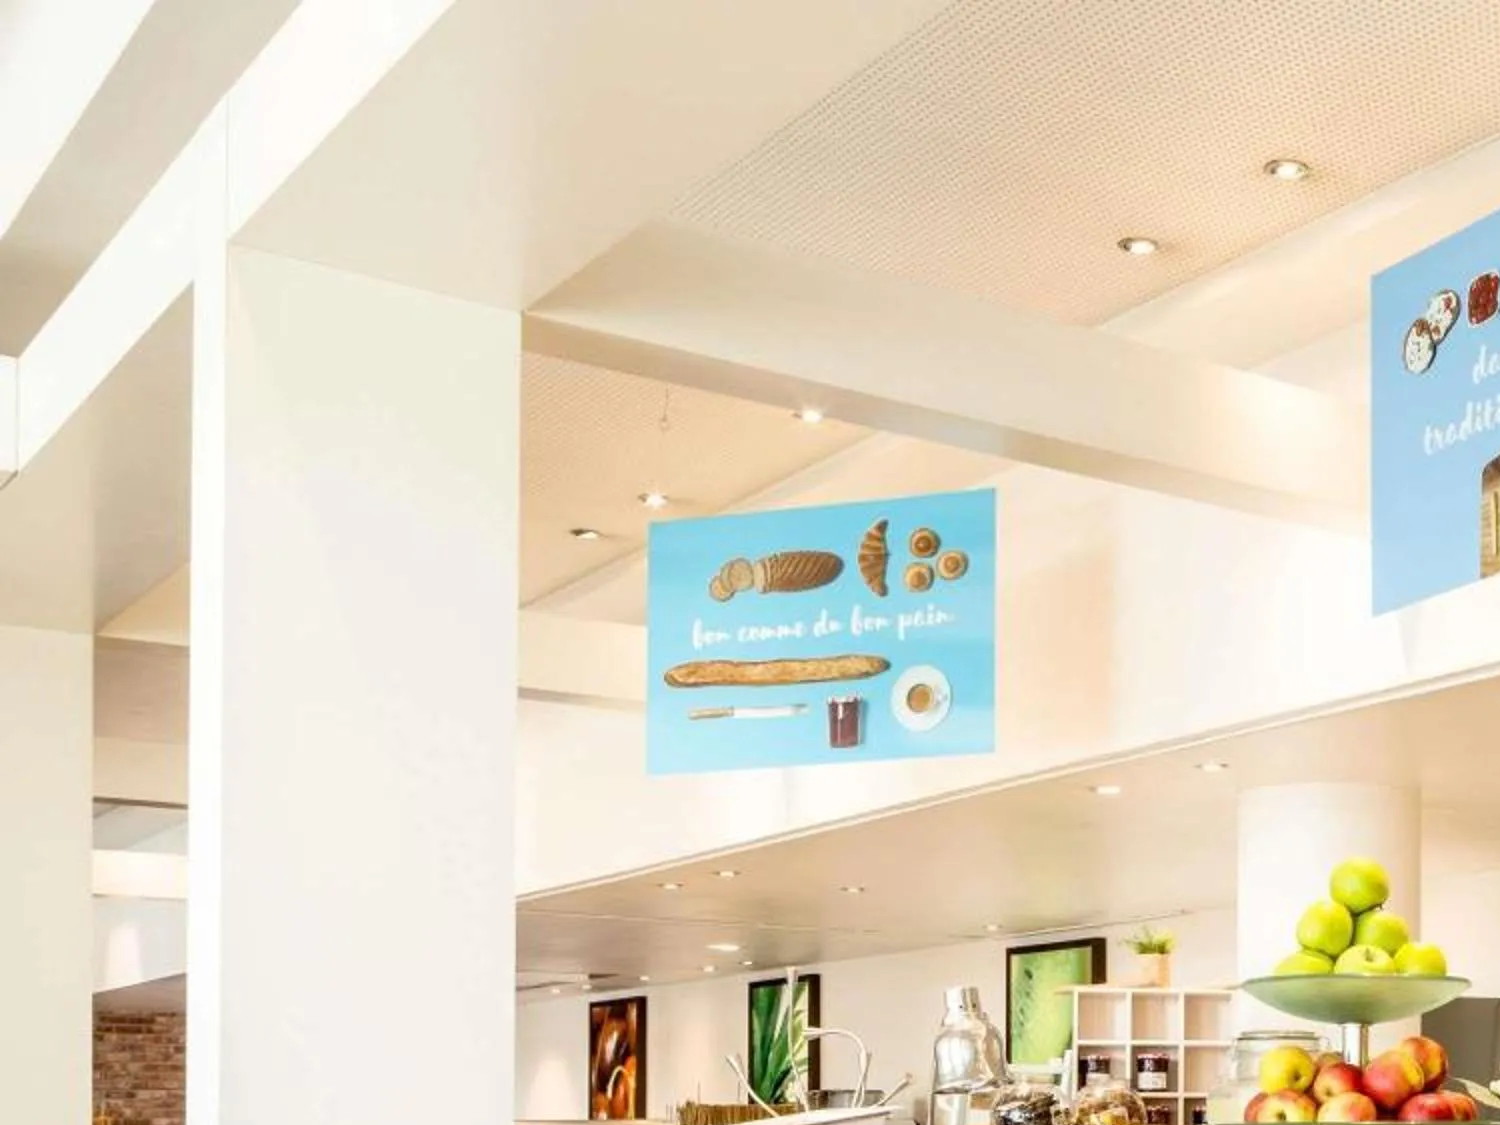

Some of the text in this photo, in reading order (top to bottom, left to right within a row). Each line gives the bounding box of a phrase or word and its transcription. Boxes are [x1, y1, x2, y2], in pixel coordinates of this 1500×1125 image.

[692, 604, 954, 649] bon comme du bon pain
